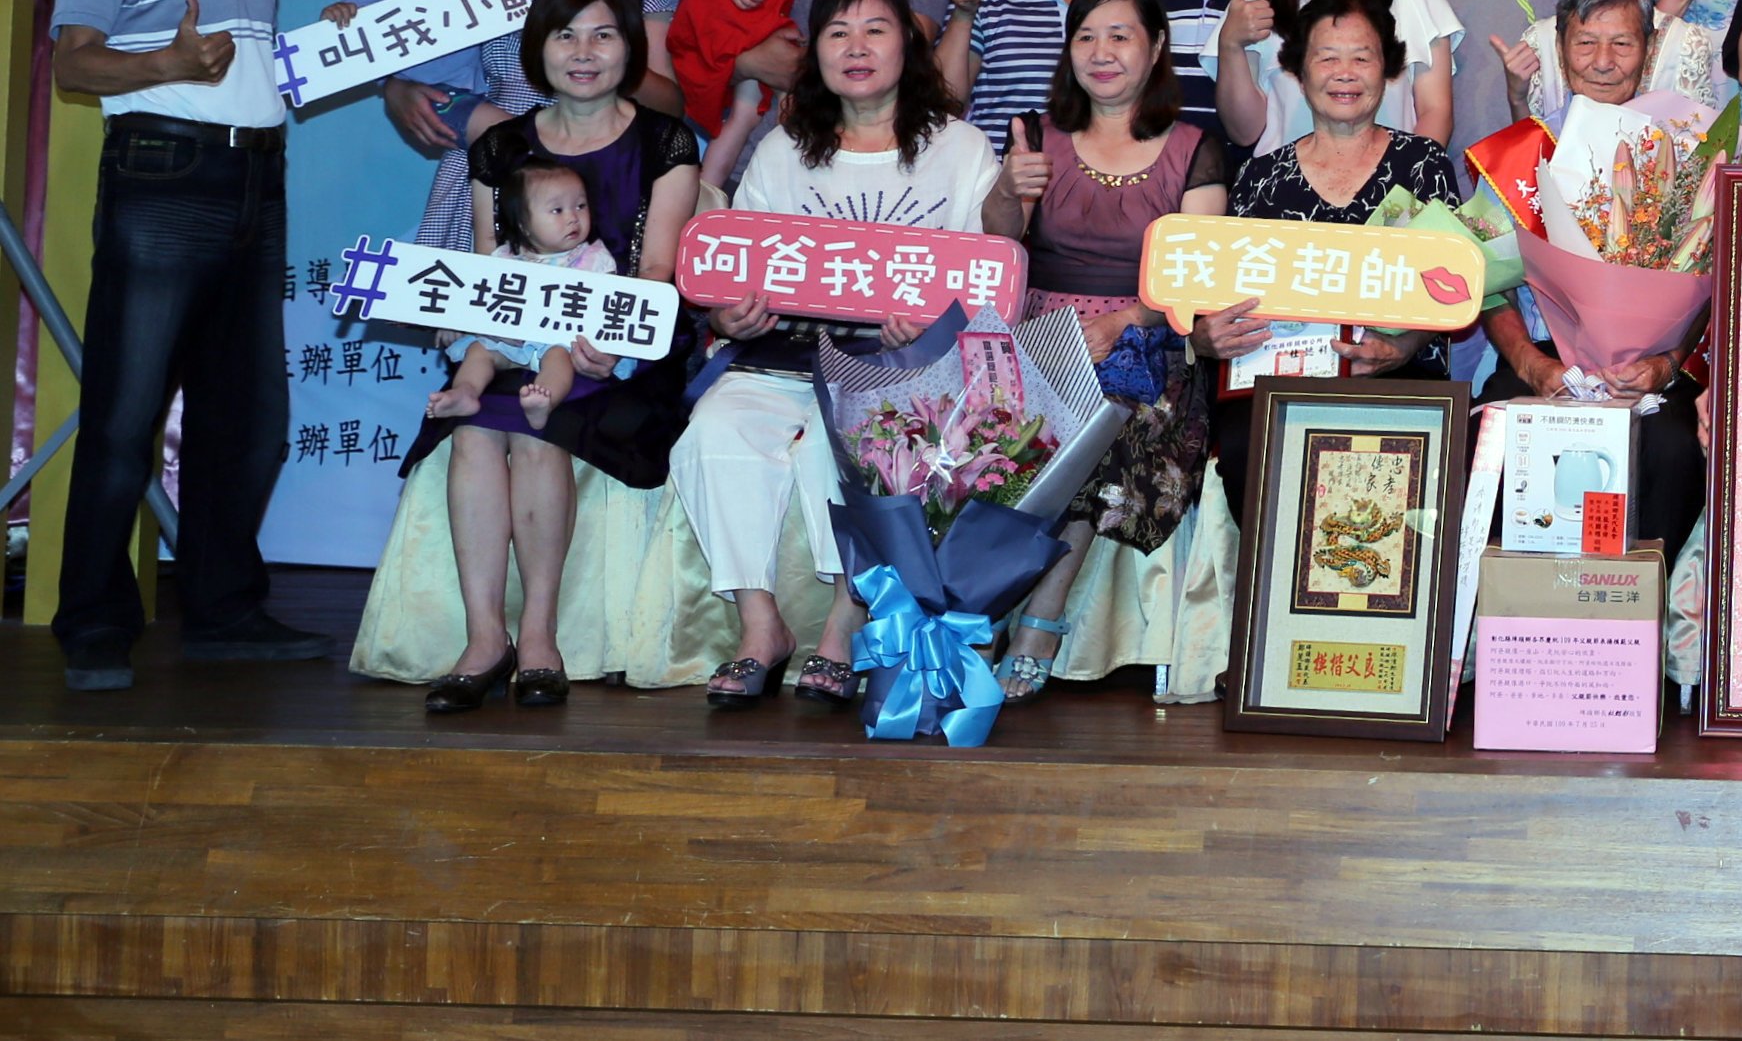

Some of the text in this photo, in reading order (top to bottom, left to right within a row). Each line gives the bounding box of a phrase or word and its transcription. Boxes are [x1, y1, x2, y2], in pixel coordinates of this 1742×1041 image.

[693, 233, 1004, 307] 阿爸我愛哩
[1162, 232, 1415, 301] 我爸超帥
[1577, 590, 1640, 603] 台灣三洋
[1579, 573, 1640, 586] SANLUX
